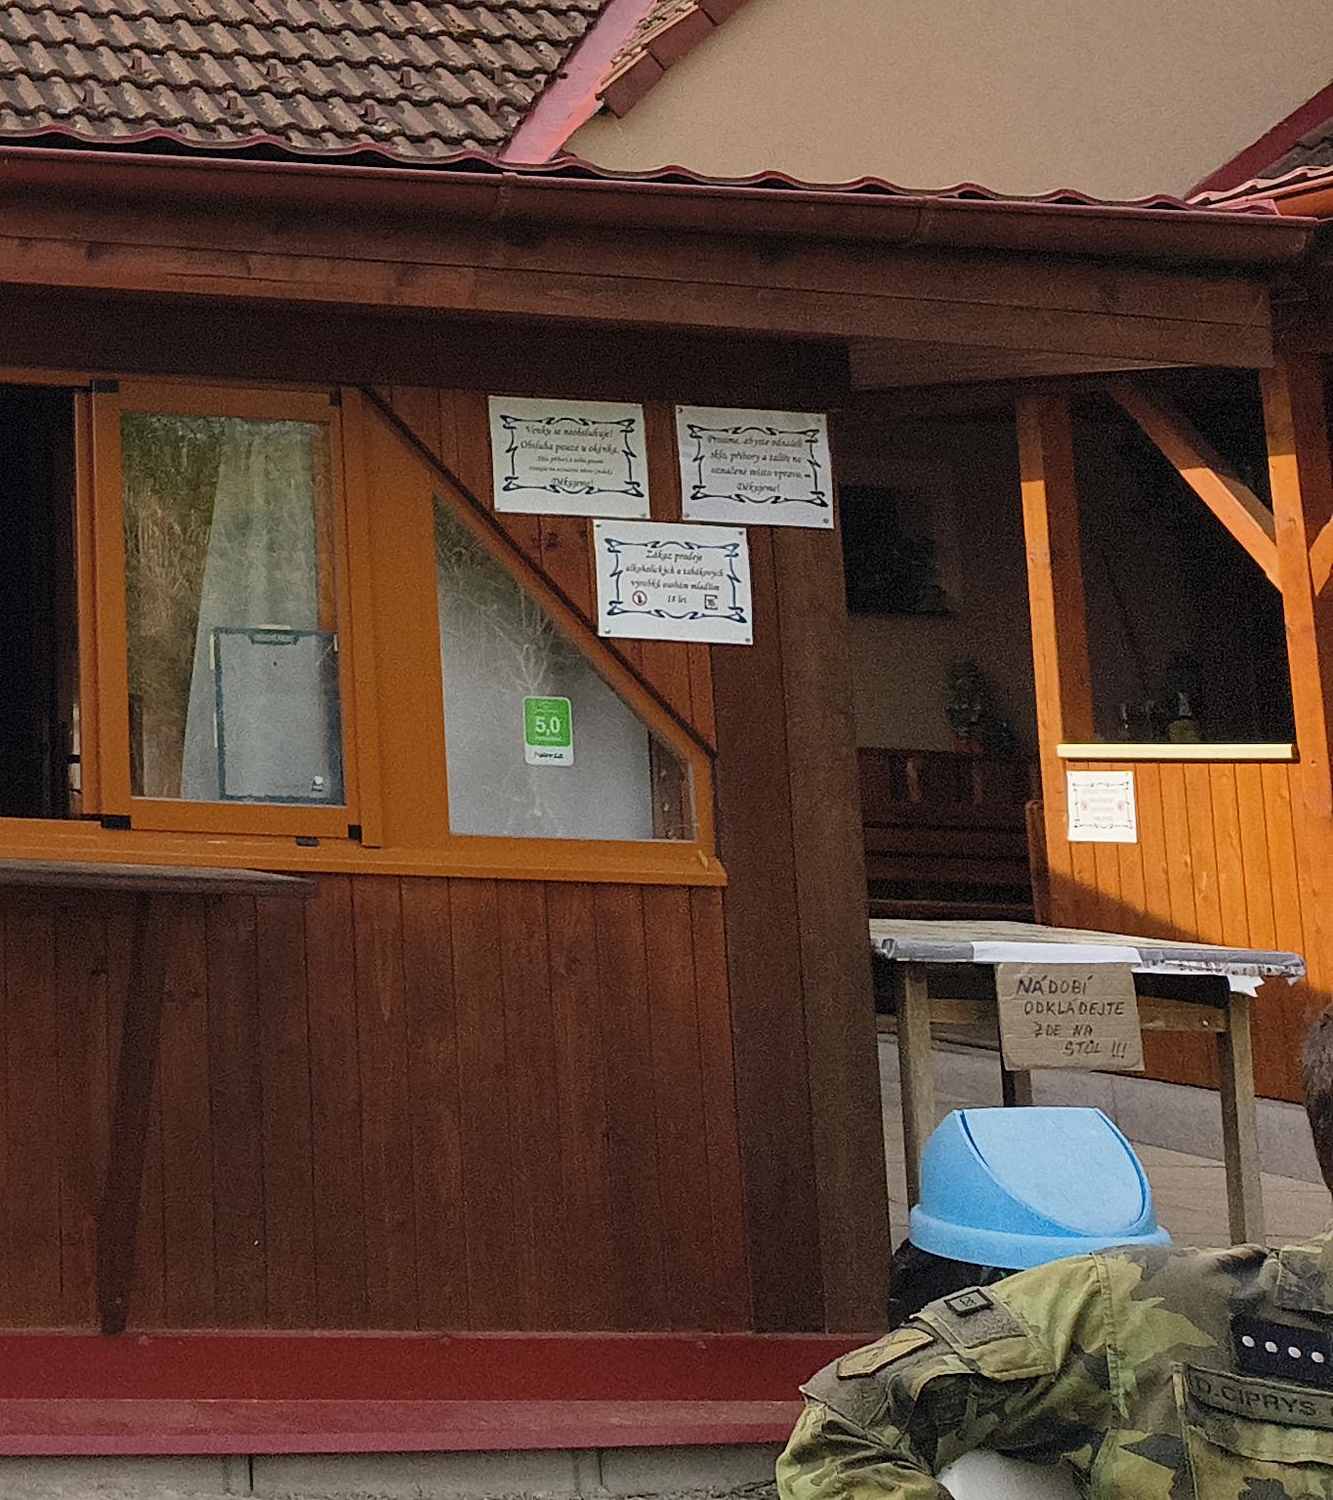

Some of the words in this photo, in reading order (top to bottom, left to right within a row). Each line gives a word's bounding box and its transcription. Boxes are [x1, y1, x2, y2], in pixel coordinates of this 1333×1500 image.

[535, 716, 560, 736] 5,0
[1016, 975, 1094, 995] NÁDOBÍ
[1024, 998, 1125, 1016] ODKLÁDEJTE
[1032, 1021, 1061, 1038] ZDE
[1073, 1024, 1093, 1036] NA
[1061, 1040, 1102, 1056] STŮL
